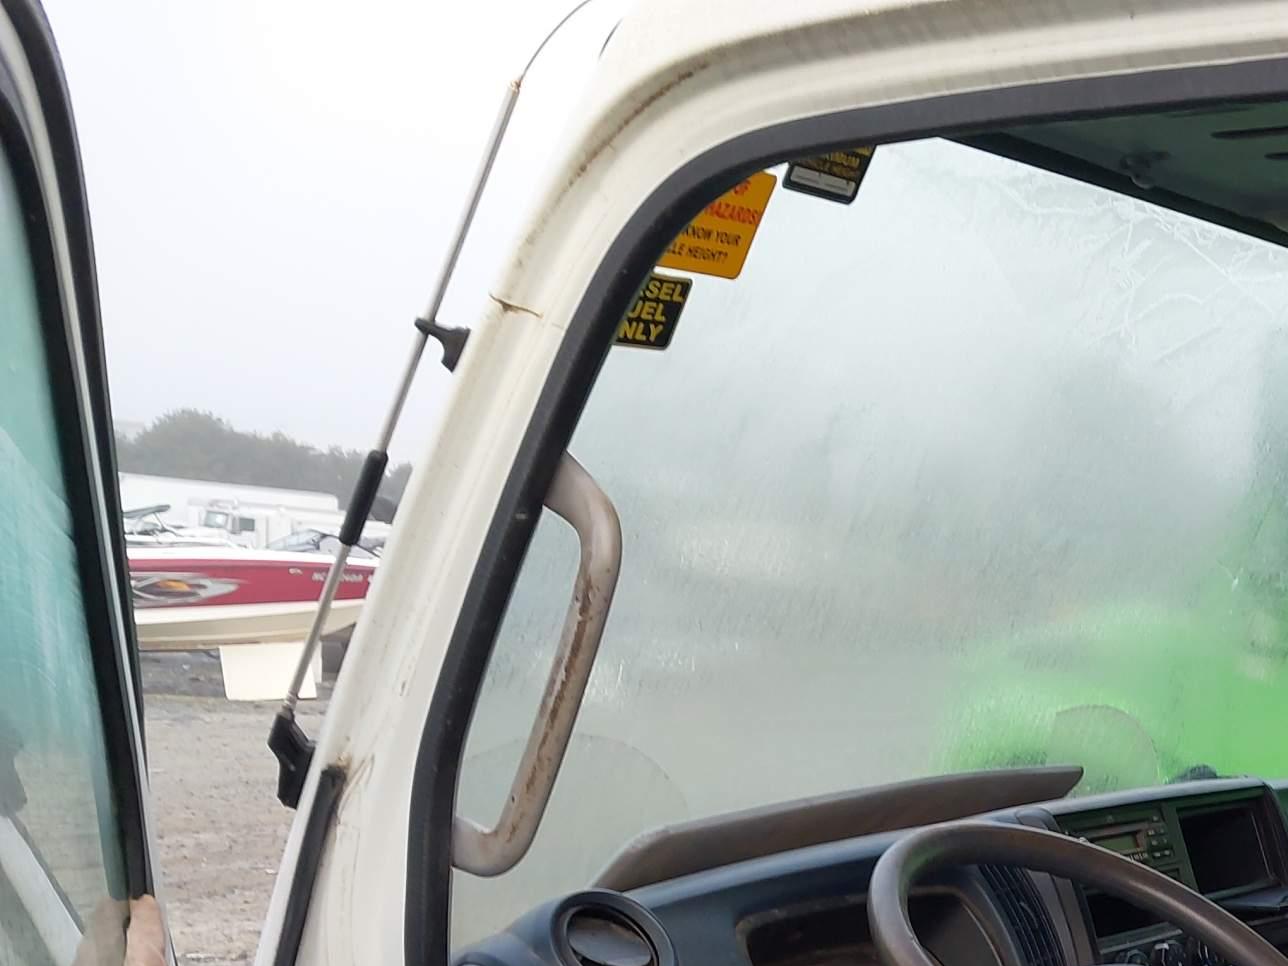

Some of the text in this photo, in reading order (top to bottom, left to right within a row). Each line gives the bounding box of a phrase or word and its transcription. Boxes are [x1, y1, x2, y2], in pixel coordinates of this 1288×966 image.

[715, 229, 742, 247] YOUR
[643, 281, 684, 303] SEL
[618, 317, 664, 342] NLY
